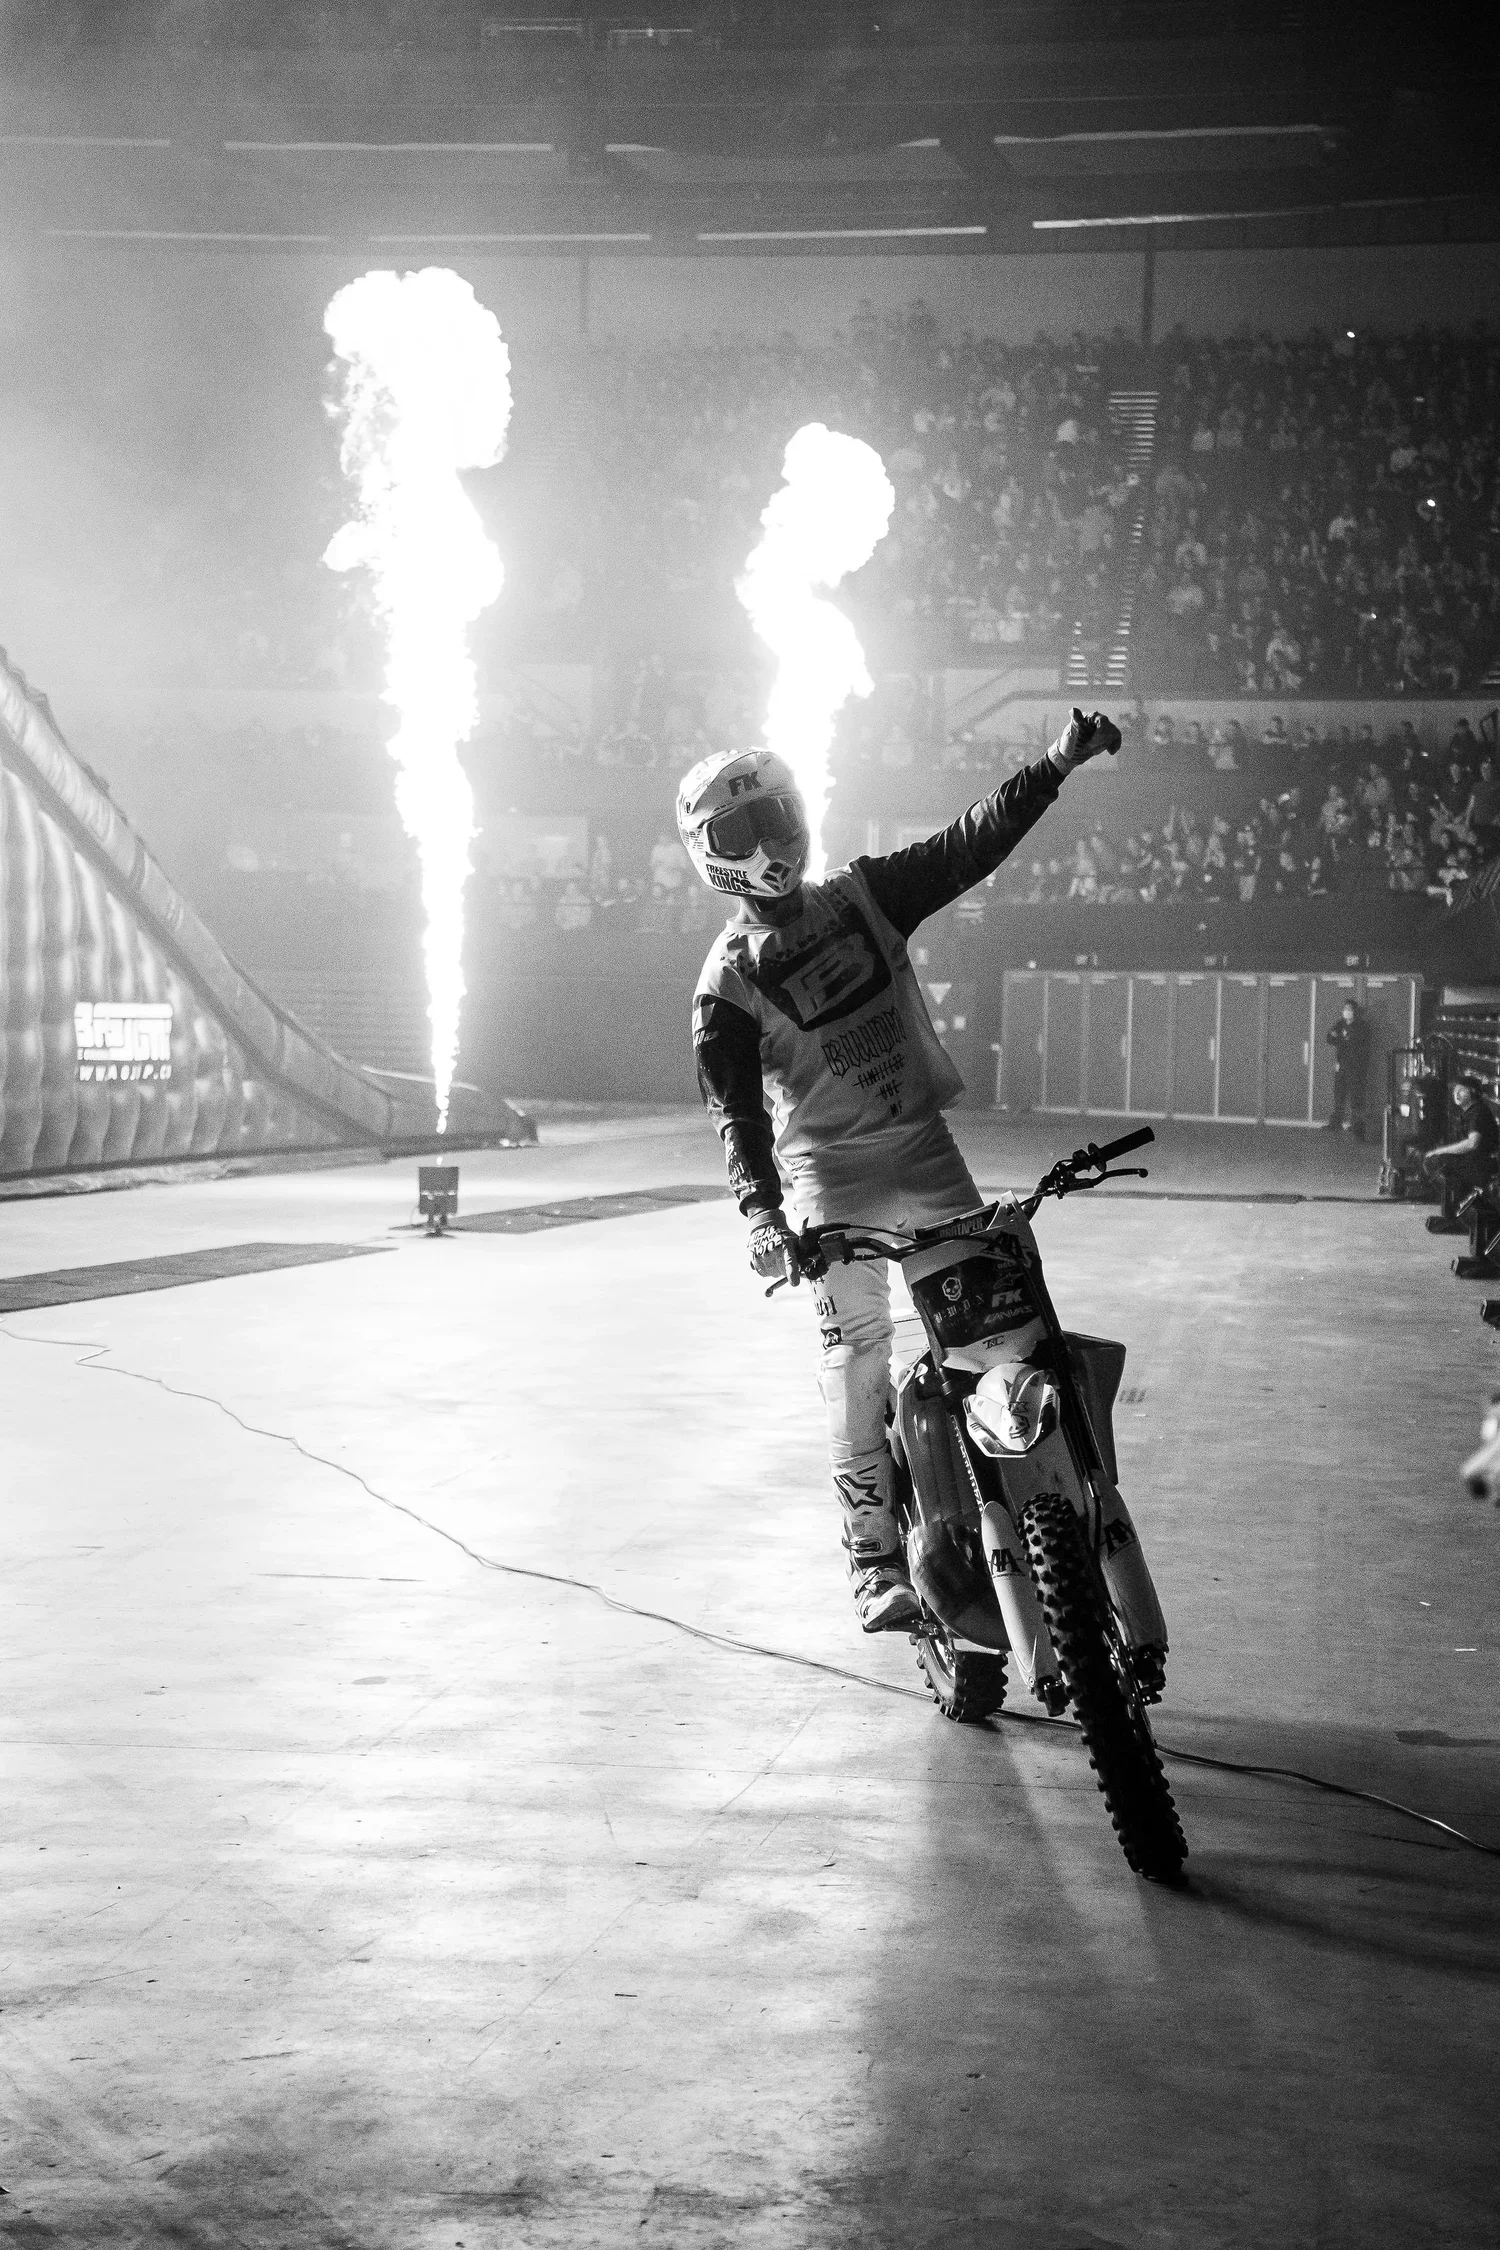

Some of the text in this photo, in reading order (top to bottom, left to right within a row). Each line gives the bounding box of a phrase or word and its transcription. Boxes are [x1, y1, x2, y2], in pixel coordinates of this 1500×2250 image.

[728, 771, 763, 797] FK
[706, 864, 749, 880] FREESTYLE
[708, 873, 753, 894] KINGS
[991, 1288, 1023, 1308] FK
[984, 1305, 1034, 1325] CANVAS
